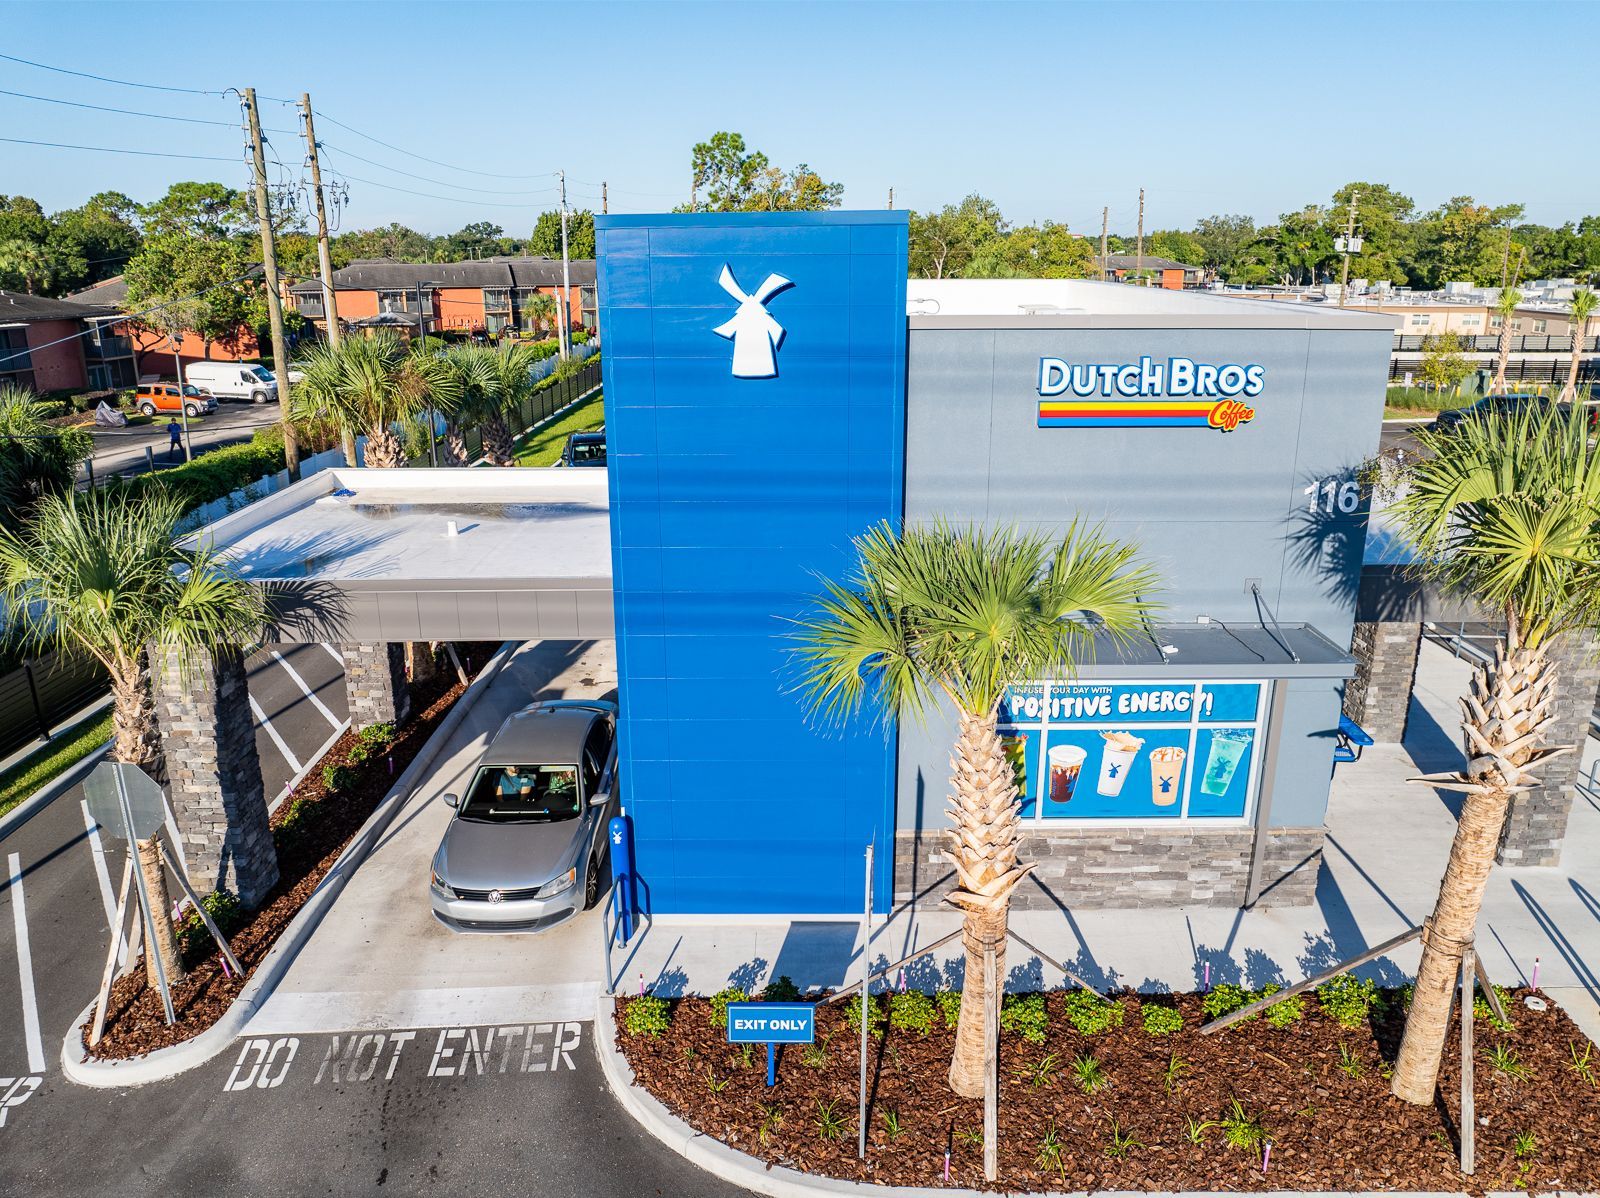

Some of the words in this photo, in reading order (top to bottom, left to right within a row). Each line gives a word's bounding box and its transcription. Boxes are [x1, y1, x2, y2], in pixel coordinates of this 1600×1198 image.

[1208, 399, 1254, 431] Coffee
[1304, 481, 1360, 513] 116
[1011, 694, 1112, 718] POSITIVE
[1118, 691, 1214, 716] ENERGY!
[734, 1019, 767, 1030] EXIT
[770, 1019, 807, 1030] ONLY
[223, 1037, 300, 1092] DO
[313, 1031, 416, 1084] NOT
[427, 1021, 582, 1078] ENTER
